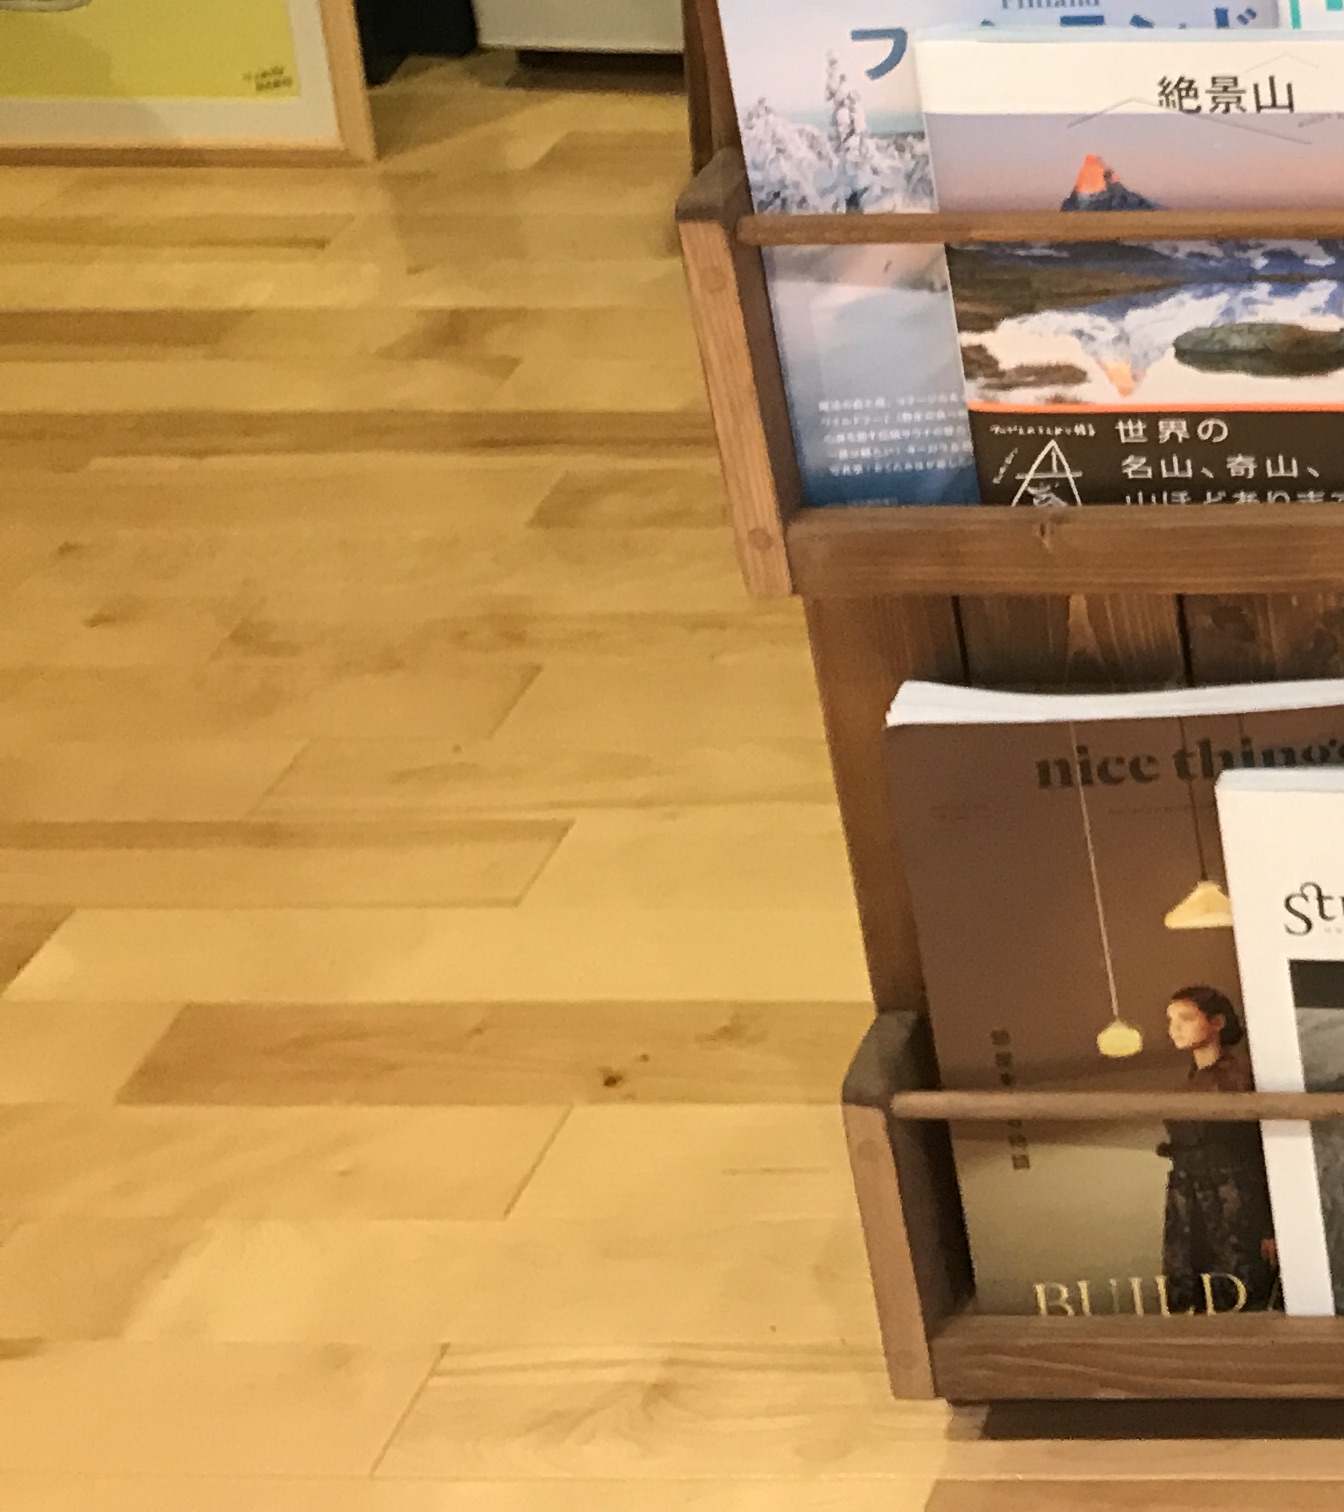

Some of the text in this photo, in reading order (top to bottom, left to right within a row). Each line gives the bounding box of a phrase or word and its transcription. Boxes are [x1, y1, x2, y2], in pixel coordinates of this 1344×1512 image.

[1156, 74, 1297, 116] 絶景山
[1114, 417, 1229, 444] 世界の
[1120, 453, 1320, 480] 名山、奇山、
[1035, 745, 1160, 789] nice
